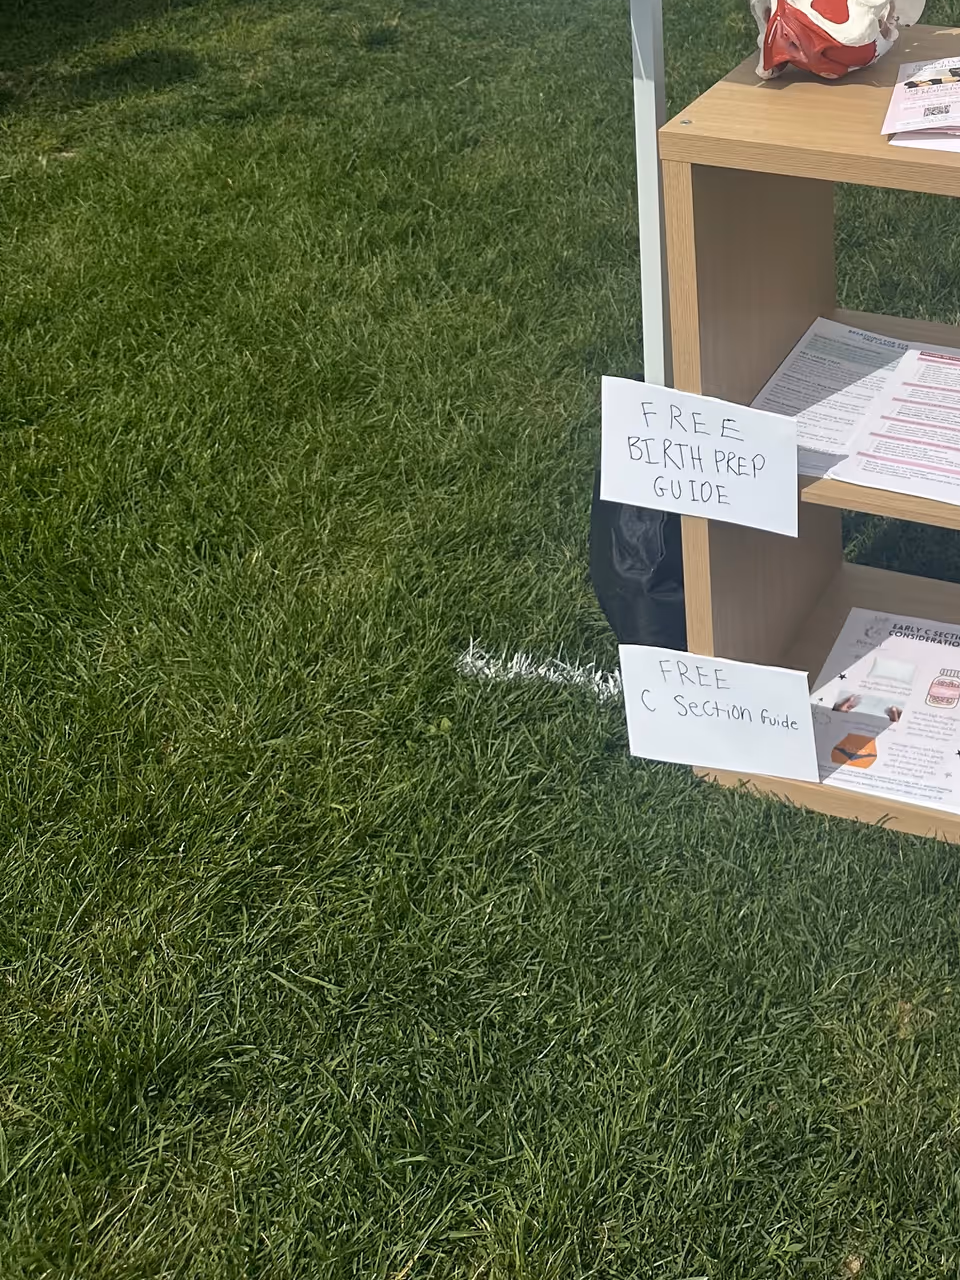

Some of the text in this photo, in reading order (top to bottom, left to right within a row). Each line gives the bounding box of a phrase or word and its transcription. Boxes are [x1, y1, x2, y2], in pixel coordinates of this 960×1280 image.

[641, 401, 745, 441] FREE
[627, 436, 766, 479] BIRTH PREP
[653, 476, 731, 505] GUIDE
[892, 623, 921, 633] EARLY
[659, 659, 731, 690] FREE
[640, 689, 799, 731] C Section Guide
